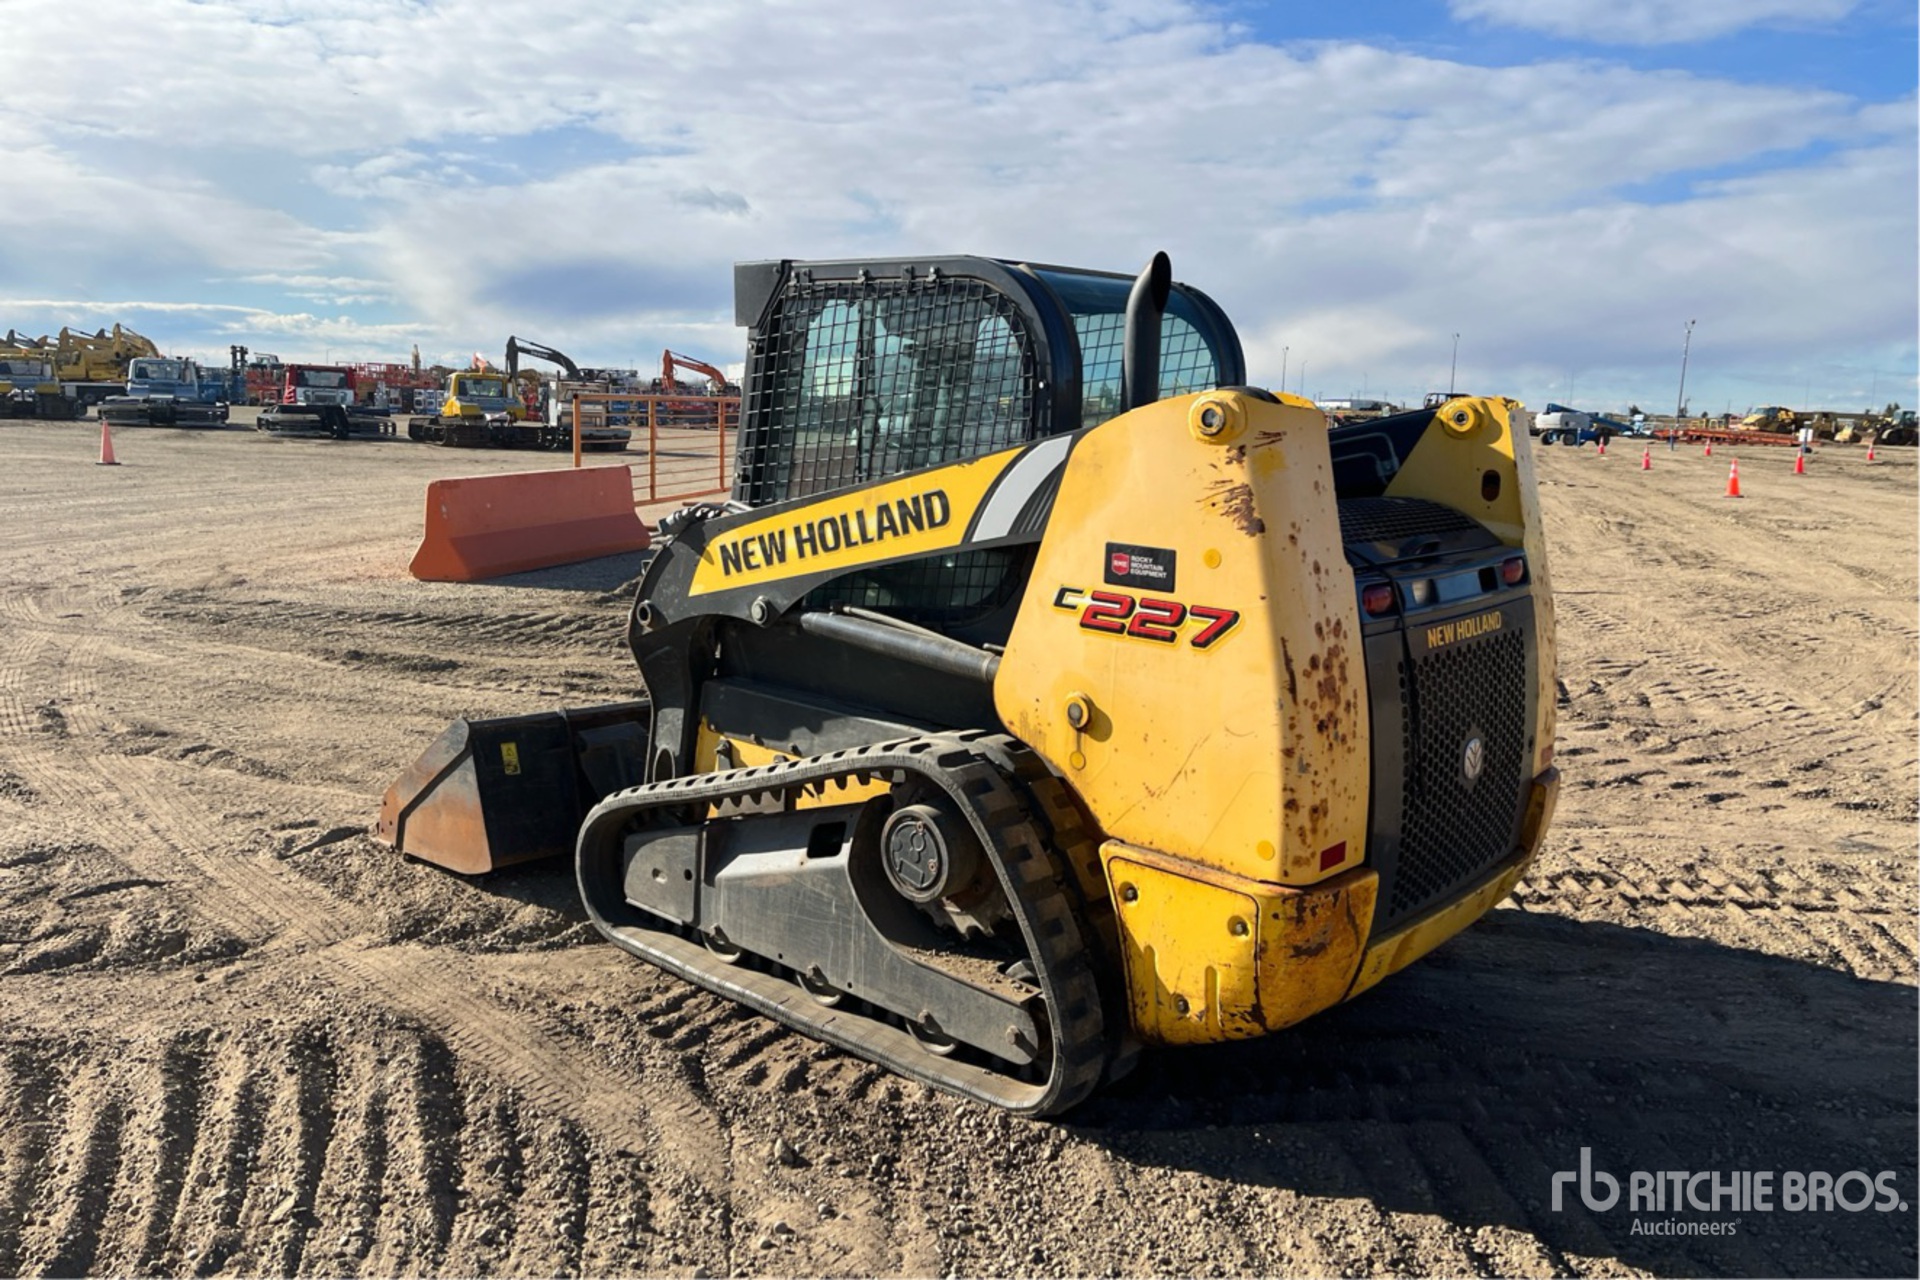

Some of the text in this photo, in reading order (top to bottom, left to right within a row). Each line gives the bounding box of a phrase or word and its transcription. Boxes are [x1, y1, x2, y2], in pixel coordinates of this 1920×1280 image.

[719, 489, 951, 576] NEW HOLLAND
[1131, 555, 1153, 563] ROCKY
[1130, 562, 1164, 571] MOUNTAIN
[1130, 568, 1167, 578] EQUIPMENT
[1427, 611, 1502, 649] NEW HOLLAND
